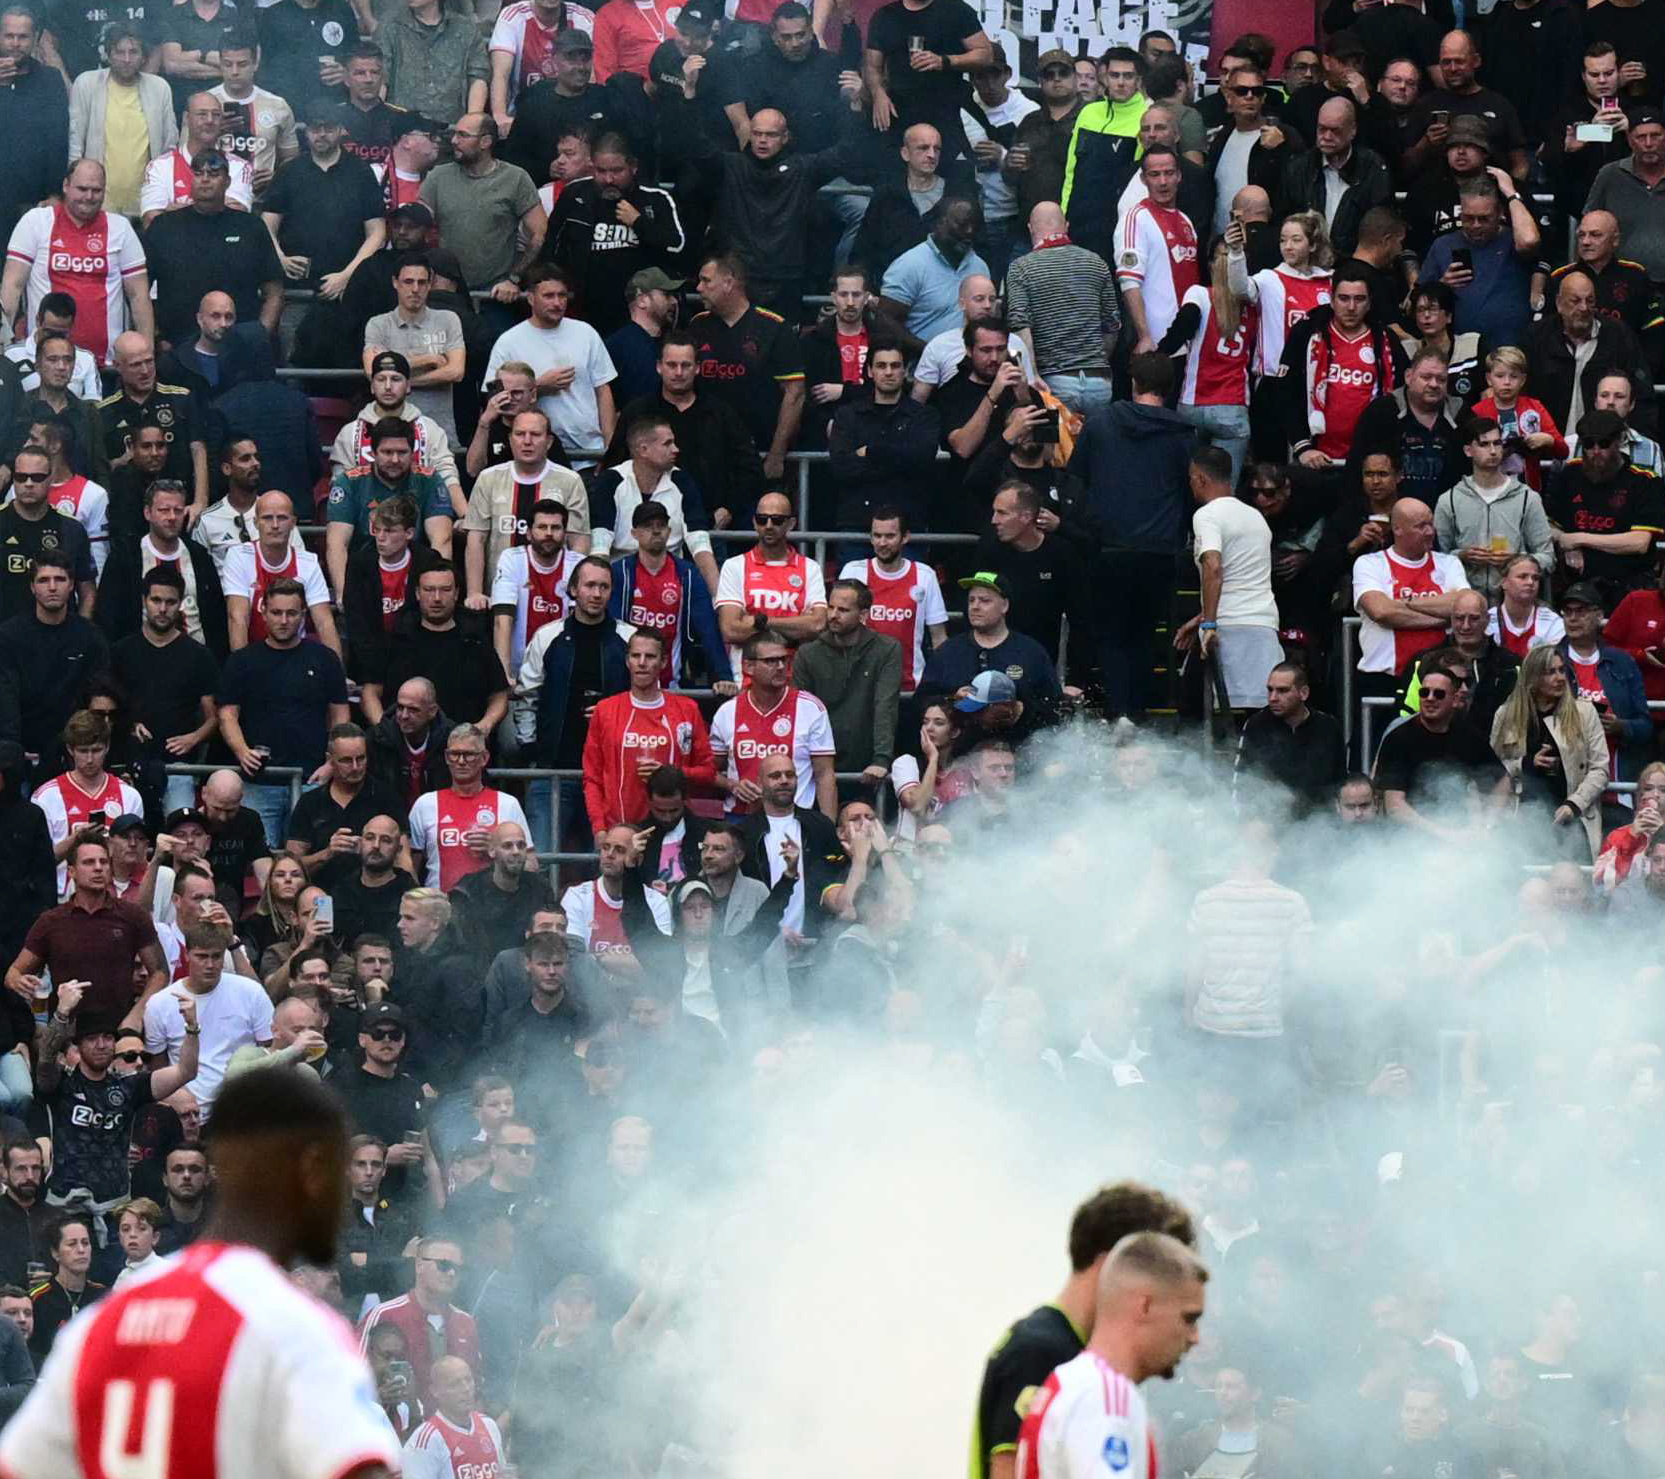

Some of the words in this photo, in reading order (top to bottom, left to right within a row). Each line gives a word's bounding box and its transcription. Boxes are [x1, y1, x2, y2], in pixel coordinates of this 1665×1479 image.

[126, 7, 144, 19] 14
[51, 254, 105, 272] Ziggo
[701, 361, 745, 379] Ziggo
[1327, 364, 1376, 383] Ziggo
[751, 590, 797, 610] TDK
[630, 608, 676, 625] Ziggo
[870, 604, 912, 620] Ziggo
[624, 732, 669, 747] Ziggo
[737, 739, 789, 758] Ziggo
[72, 1105, 122, 1129] Ziggo
